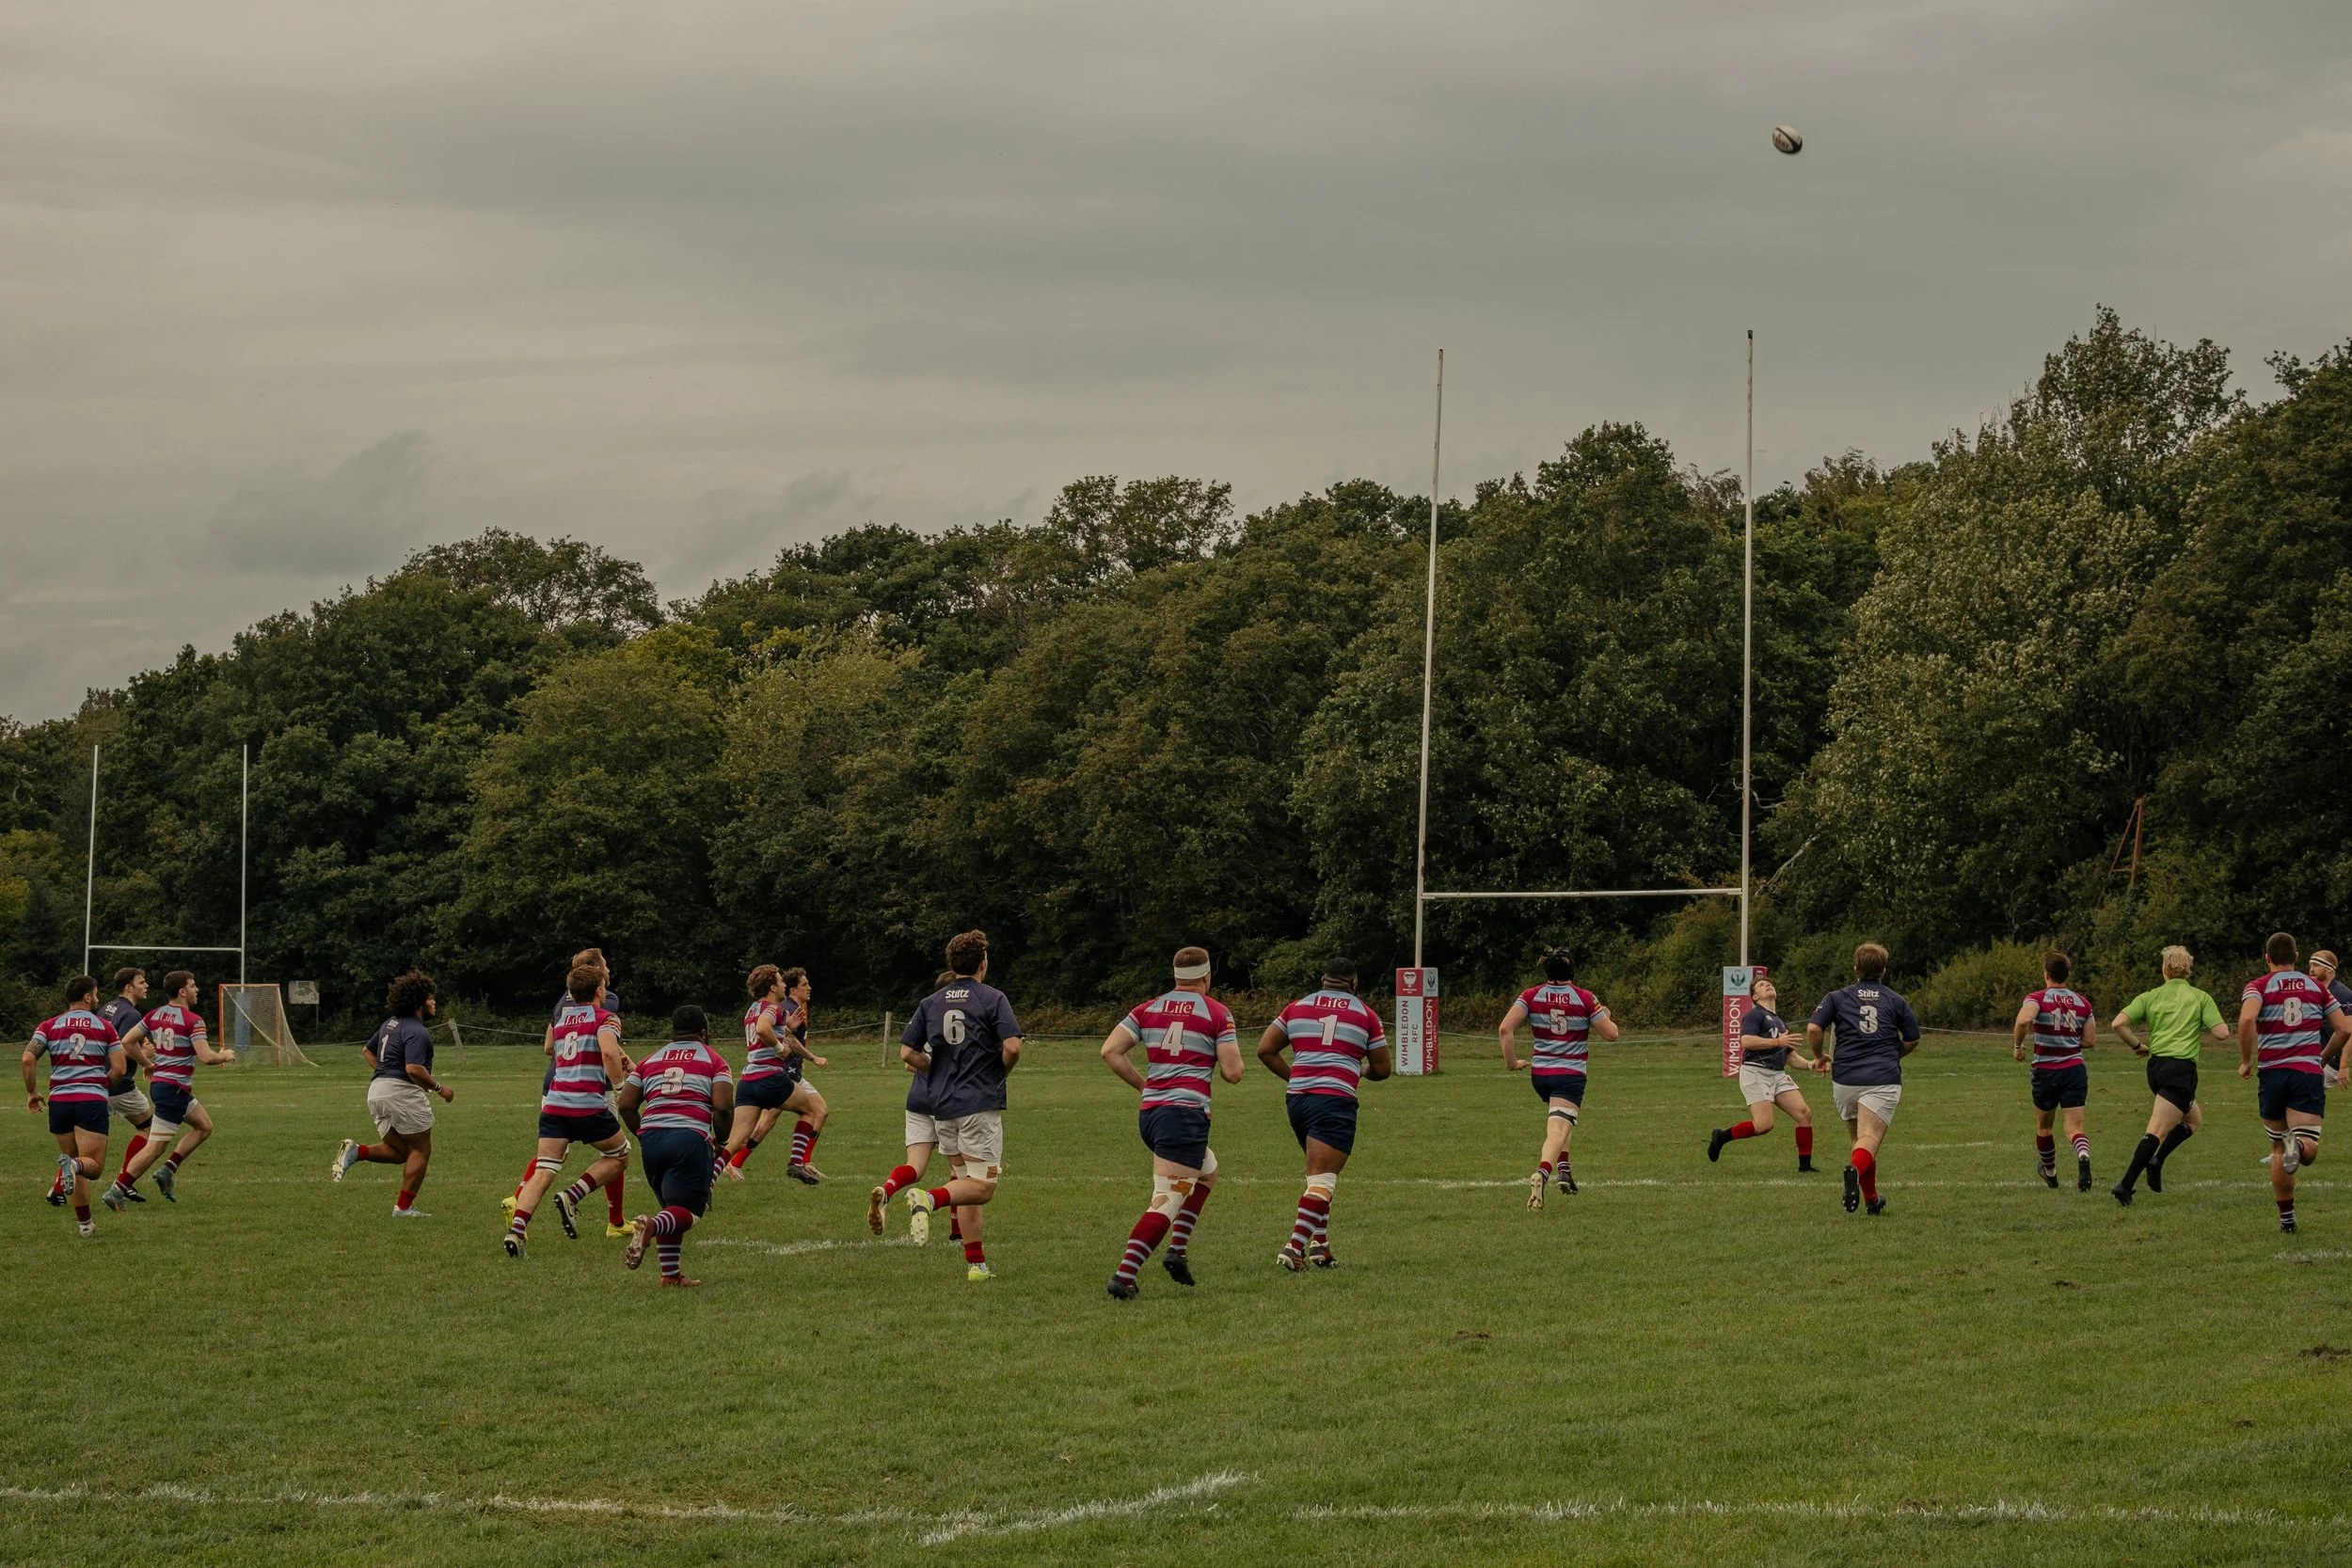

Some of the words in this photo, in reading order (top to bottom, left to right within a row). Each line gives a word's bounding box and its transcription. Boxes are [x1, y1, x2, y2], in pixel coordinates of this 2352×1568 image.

[946, 989, 969, 999] Stiltz
[1548, 991, 1568, 1004] Life
[1857, 989, 1880, 998] Stiltz
[2280, 978, 2304, 990] Life
[1164, 1000, 1192, 1014] Life
[1316, 996, 1347, 1008] Life
[2283, 997, 2303, 1026] 8
[67, 1017, 90, 1027] Life
[160, 1011, 176, 1022] Life
[944, 1009, 965, 1044] 6
[1318, 1014, 1338, 1046] 1
[1549, 1009, 1567, 1035] 5
[1859, 1006, 1878, 1034] 3
[69, 1033, 86, 1060] 2
[155, 1026, 175, 1052] 13
[562, 1031, 579, 1060] 6
[1161, 1021, 1184, 1056] 4
[1401, 1000, 1409, 1067] WIMBLEDON
[1425, 999, 1434, 1072] WIMBLEDON
[1728, 997, 1740, 1076] WIMBLEDON
[379, 1034, 389, 1063] 1
[664, 1050, 693, 1061] Life
[660, 1067, 684, 1095] 3
